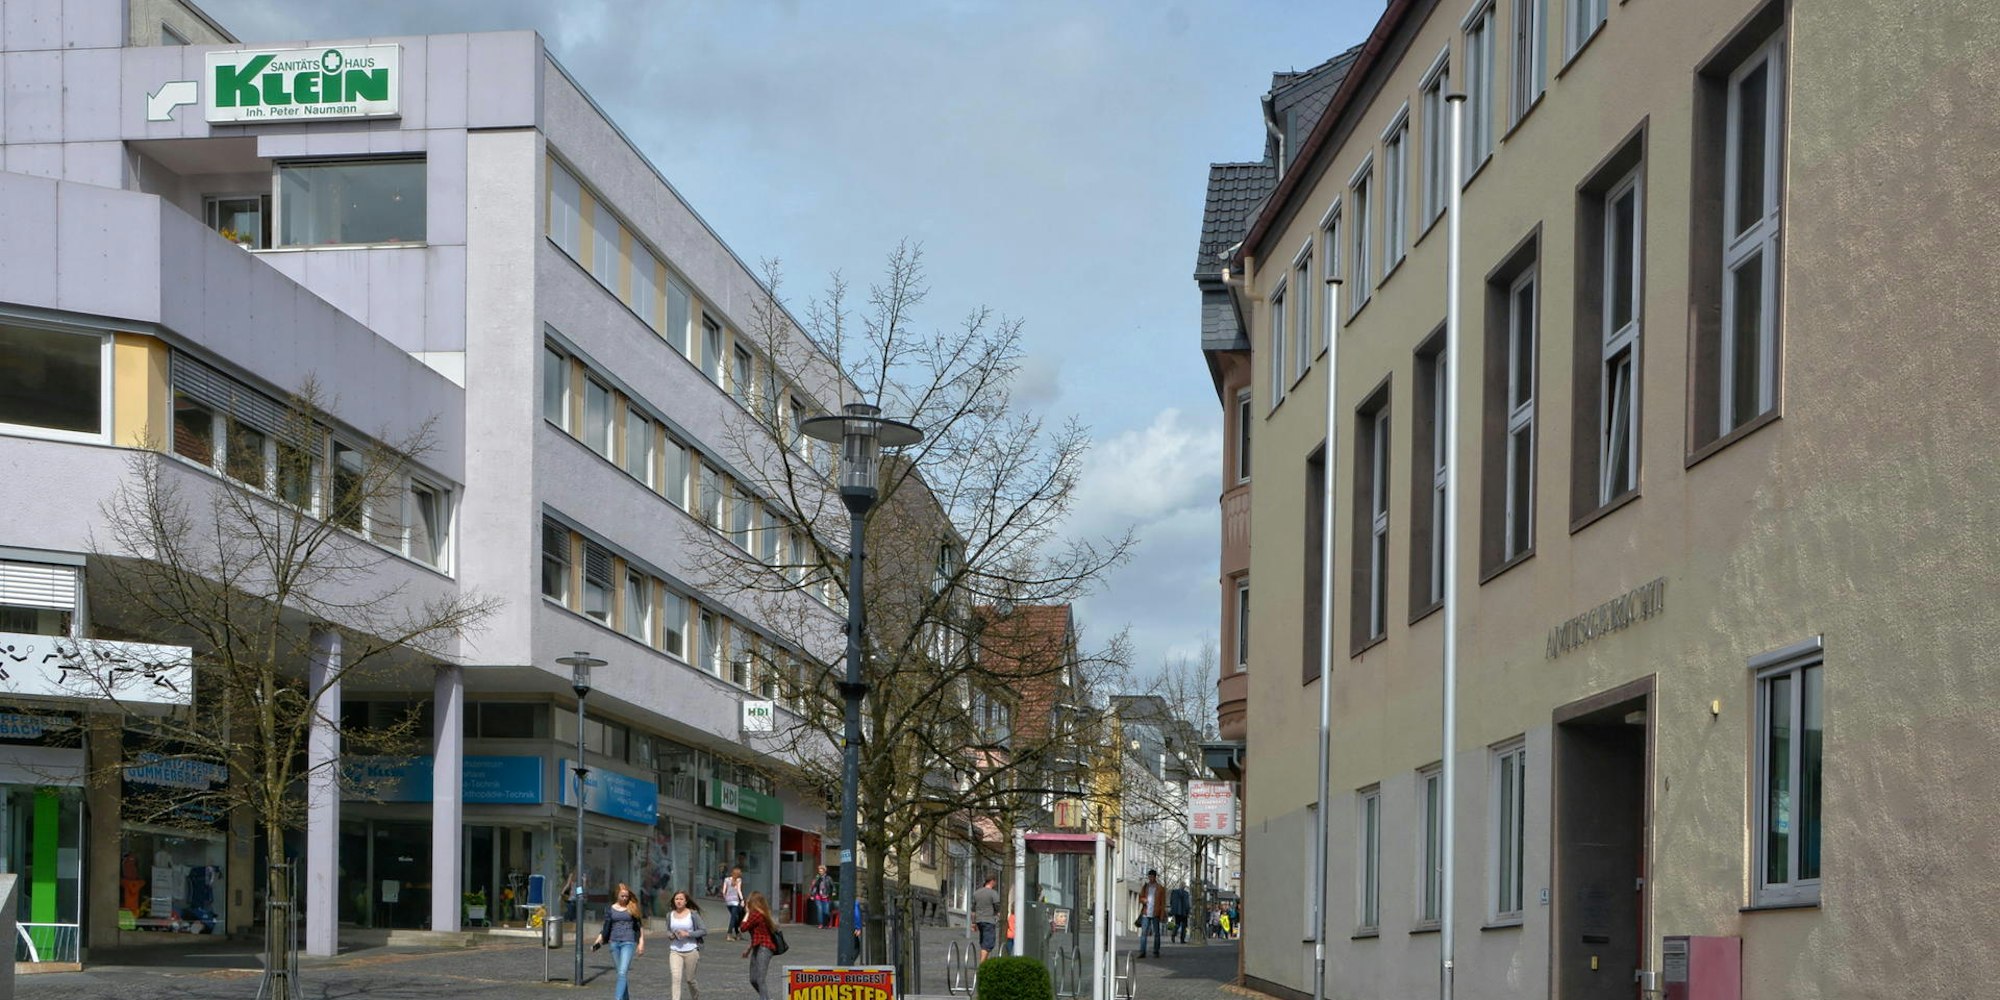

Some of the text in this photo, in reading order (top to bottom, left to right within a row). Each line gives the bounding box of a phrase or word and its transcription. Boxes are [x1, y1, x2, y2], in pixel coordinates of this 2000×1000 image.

[270, 57, 375, 72] SANITÄTS HAUS
[246, 104, 357, 117] Inh. Peter Naumann
[747, 707, 768, 716] HDI
[723, 786, 738, 807] HDI
[845, 974, 887, 984] BIGGEST
[793, 984, 888, 1000] MONSTER
